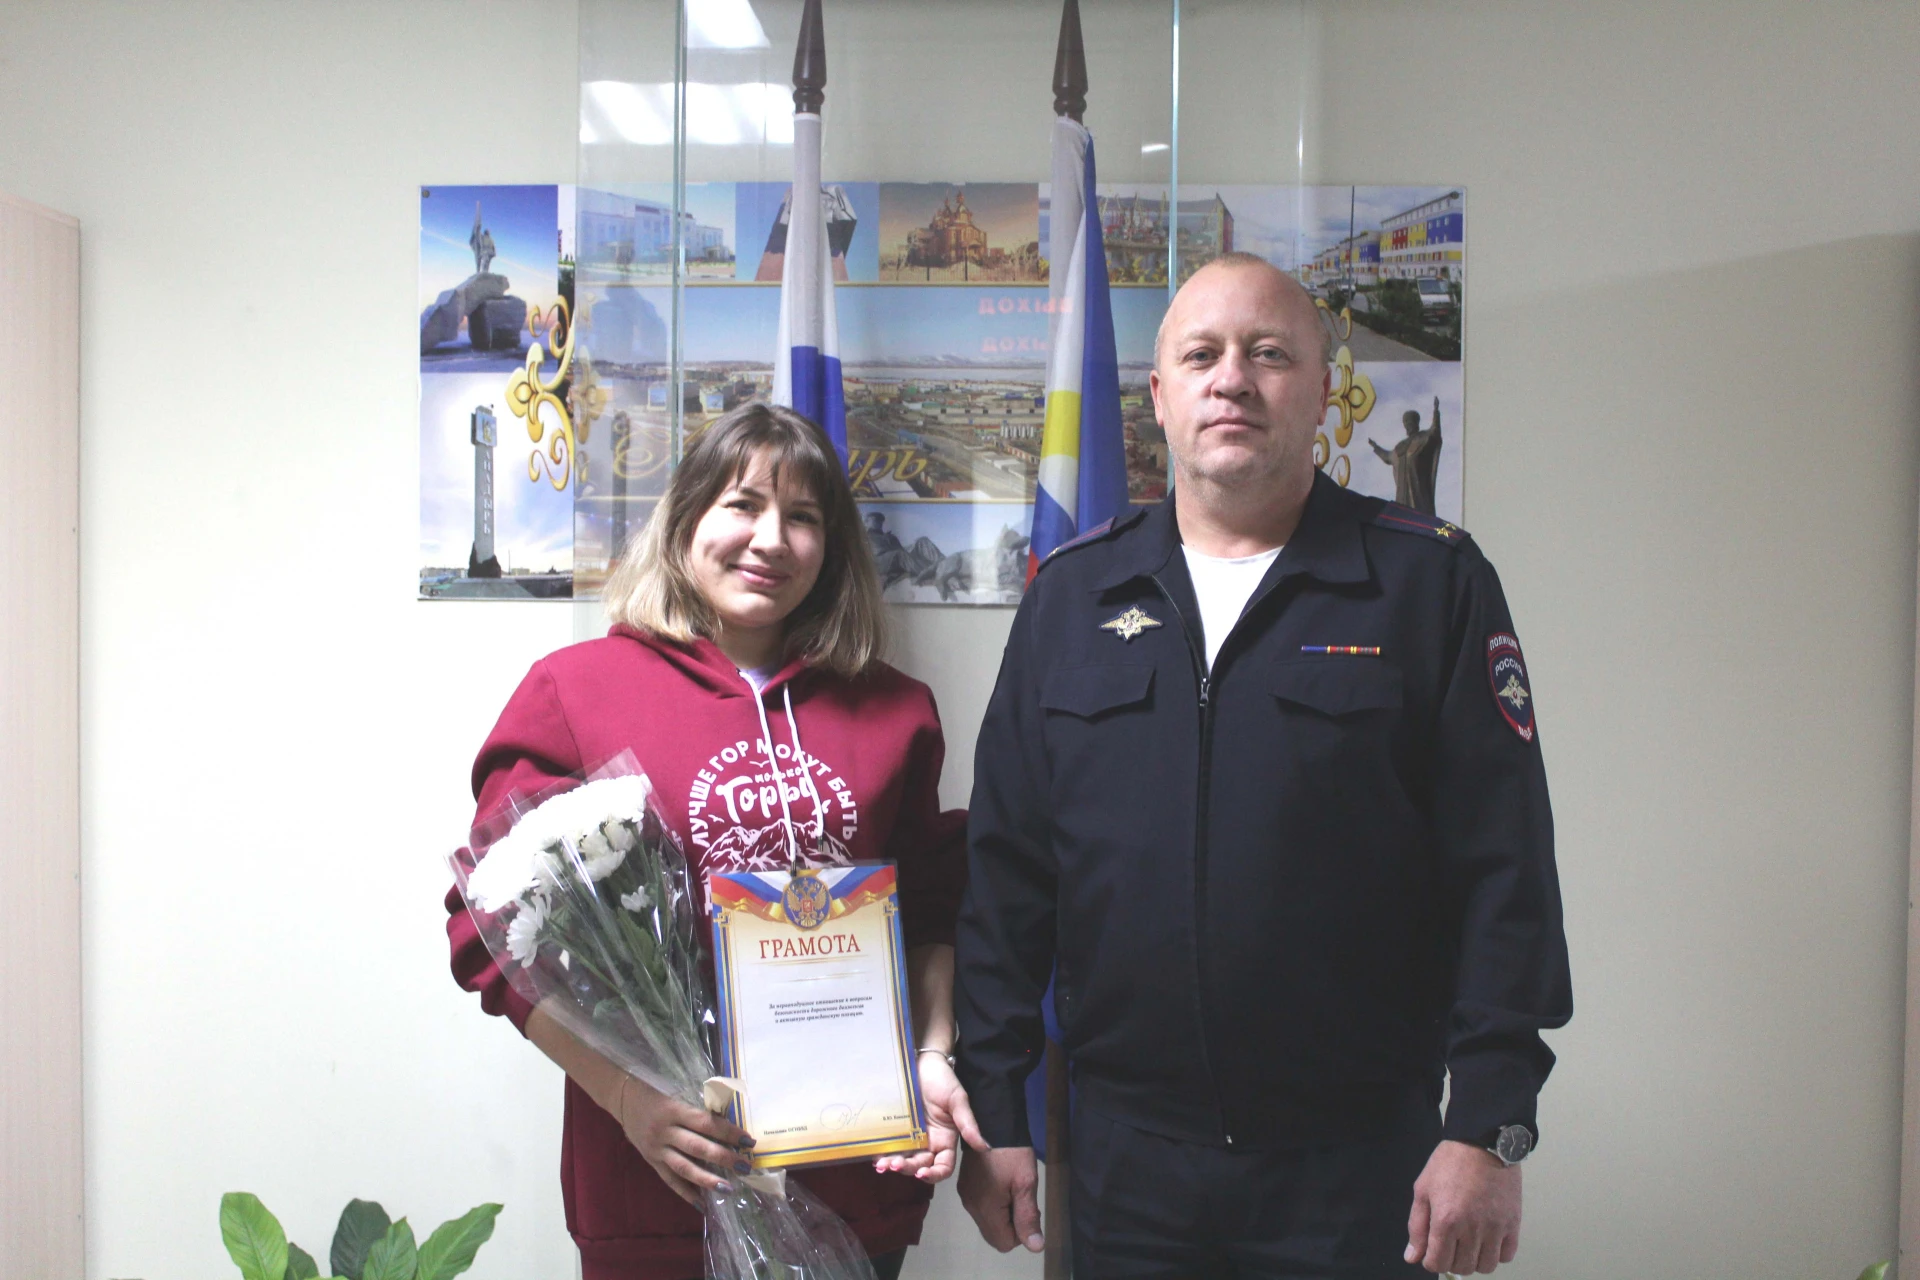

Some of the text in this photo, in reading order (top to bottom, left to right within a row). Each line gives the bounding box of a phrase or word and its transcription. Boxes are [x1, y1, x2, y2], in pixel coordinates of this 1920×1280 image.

[1489, 635, 1518, 651] ПОЛИЦИЯ
[1495, 658, 1523, 677] РОССИЯ
[688, 768, 718, 848] ЛУЧШЕ
[709, 740, 749, 772] ГОР
[827, 776, 858, 841] БЫТЬ
[715, 775, 813, 824] Горы
[759, 934, 861, 959] ГРАМОТА
